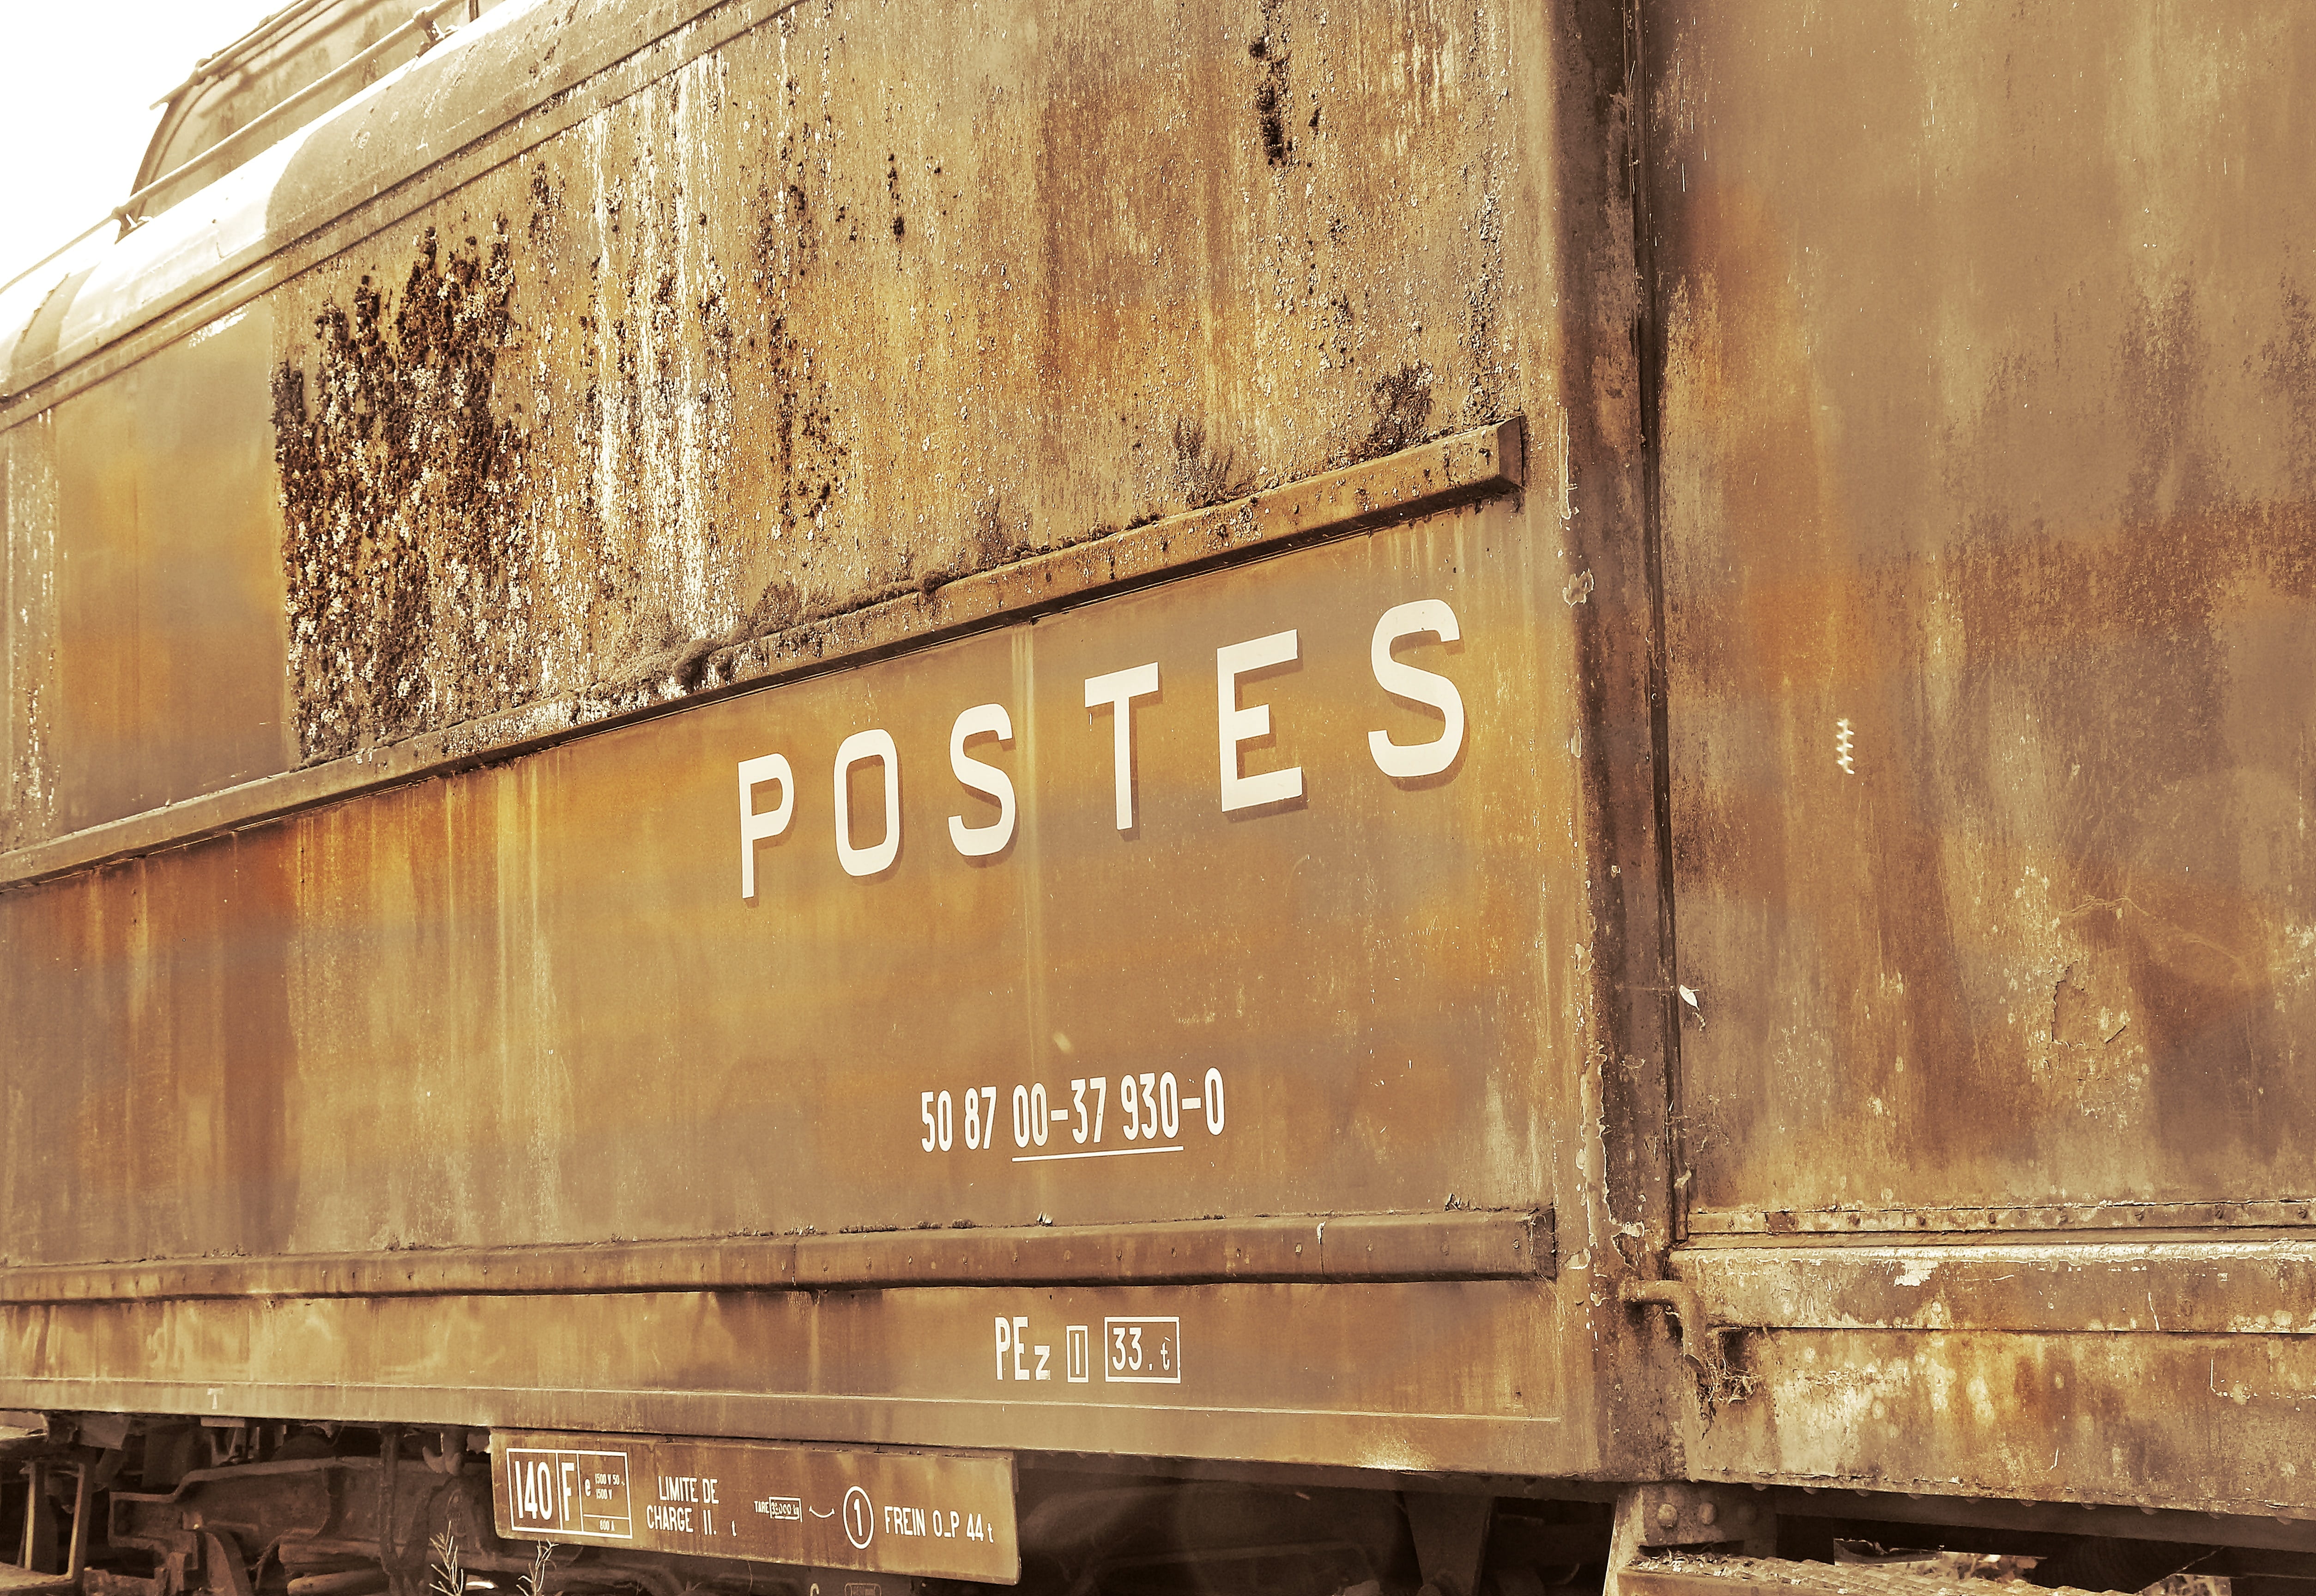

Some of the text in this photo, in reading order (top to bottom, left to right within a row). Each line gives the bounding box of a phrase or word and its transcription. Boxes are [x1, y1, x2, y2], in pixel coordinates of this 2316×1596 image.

[738, 598, 1464, 899] POSTES
[921, 1067, 1225, 1152] 50 87 00-37 930-0
[561, 1462, 575, 1521] F
[658, 1475, 720, 1504] LIMITE DE
[754, 1500, 770, 1513] TARE
[646, 1505, 694, 1533] CHARGE
[853, 1498, 863, 1537] 1
[884, 1505, 926, 1537] FREIN
[966, 1513, 985, 1542] 44
[987, 1523, 994, 1543] t
